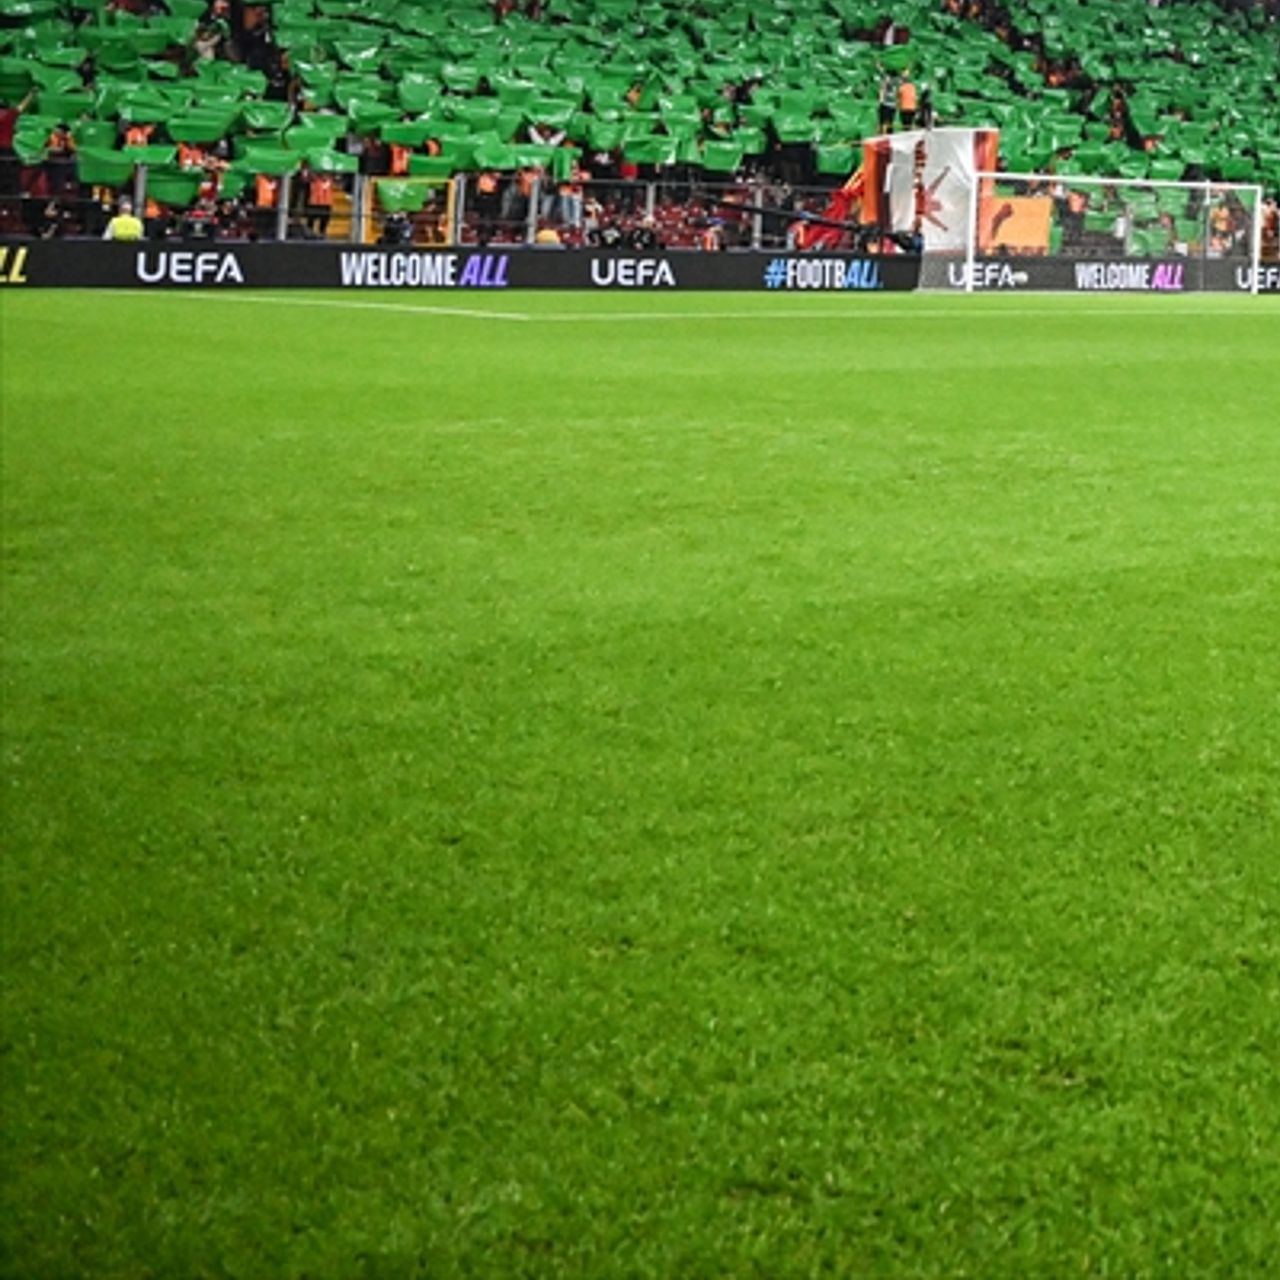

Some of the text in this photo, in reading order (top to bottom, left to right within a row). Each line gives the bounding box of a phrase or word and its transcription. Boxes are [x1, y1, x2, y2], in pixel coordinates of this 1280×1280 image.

[136, 253, 244, 283] UEFA
[341, 253, 509, 286] WELCOME ALL
[591, 258, 676, 286] UEFA
[948, 262, 1016, 288] UEFA
[1075, 263, 1185, 290] WELCOME ALL
